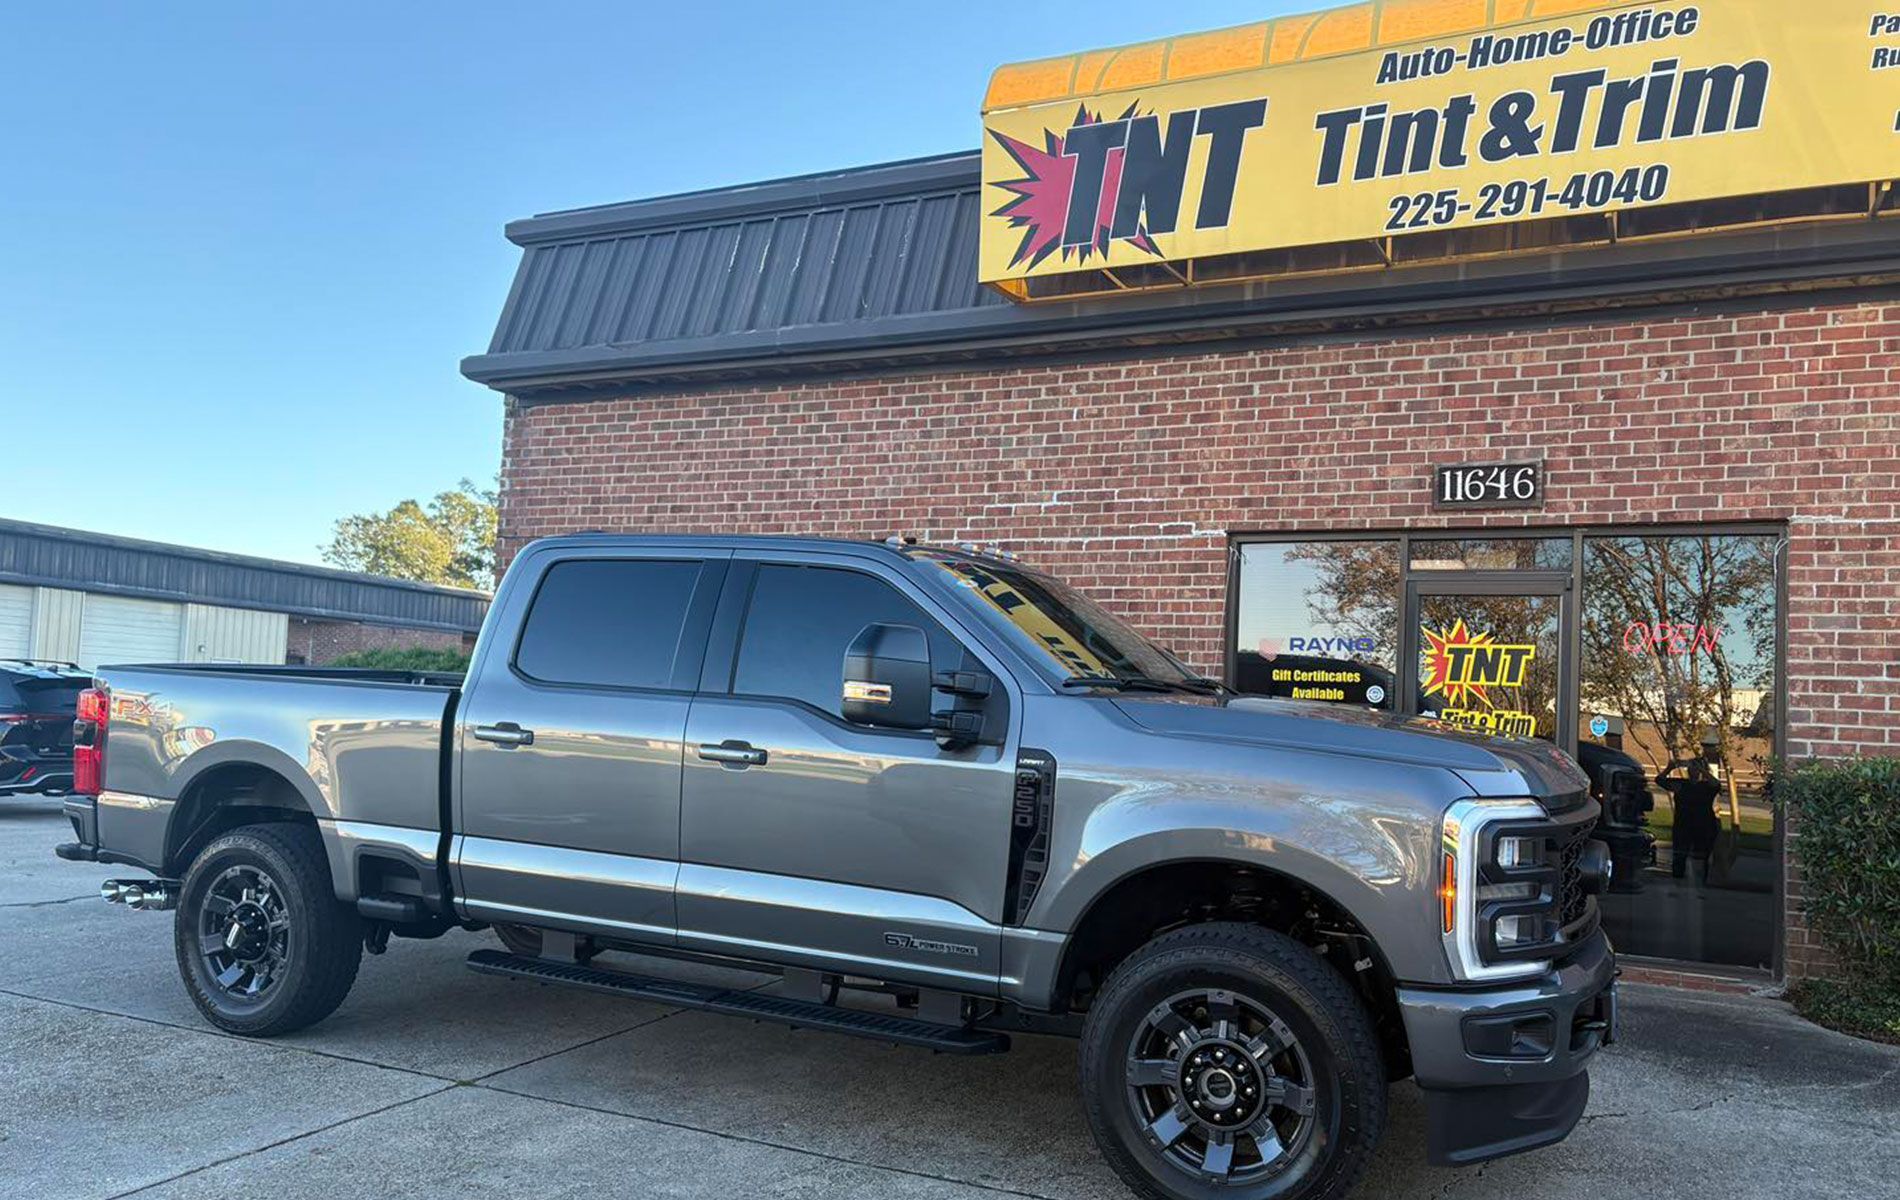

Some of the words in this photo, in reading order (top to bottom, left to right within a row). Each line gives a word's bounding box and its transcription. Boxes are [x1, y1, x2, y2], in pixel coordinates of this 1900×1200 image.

[1376, 6, 1699, 85] Auto-Home-Office
[1061, 97, 1269, 248] TNT
[1383, 163, 1670, 232] 225-291-4040
[1441, 466, 1535, 501] 11646
[1623, 621, 1722, 654] OPEN
[1272, 668, 1292, 682] Gift
[1293, 669, 1361, 683] Certificates
[1443, 644, 1536, 687] TNT
[116, 698, 175, 719] FX4
[1292, 687, 1345, 701] Available
